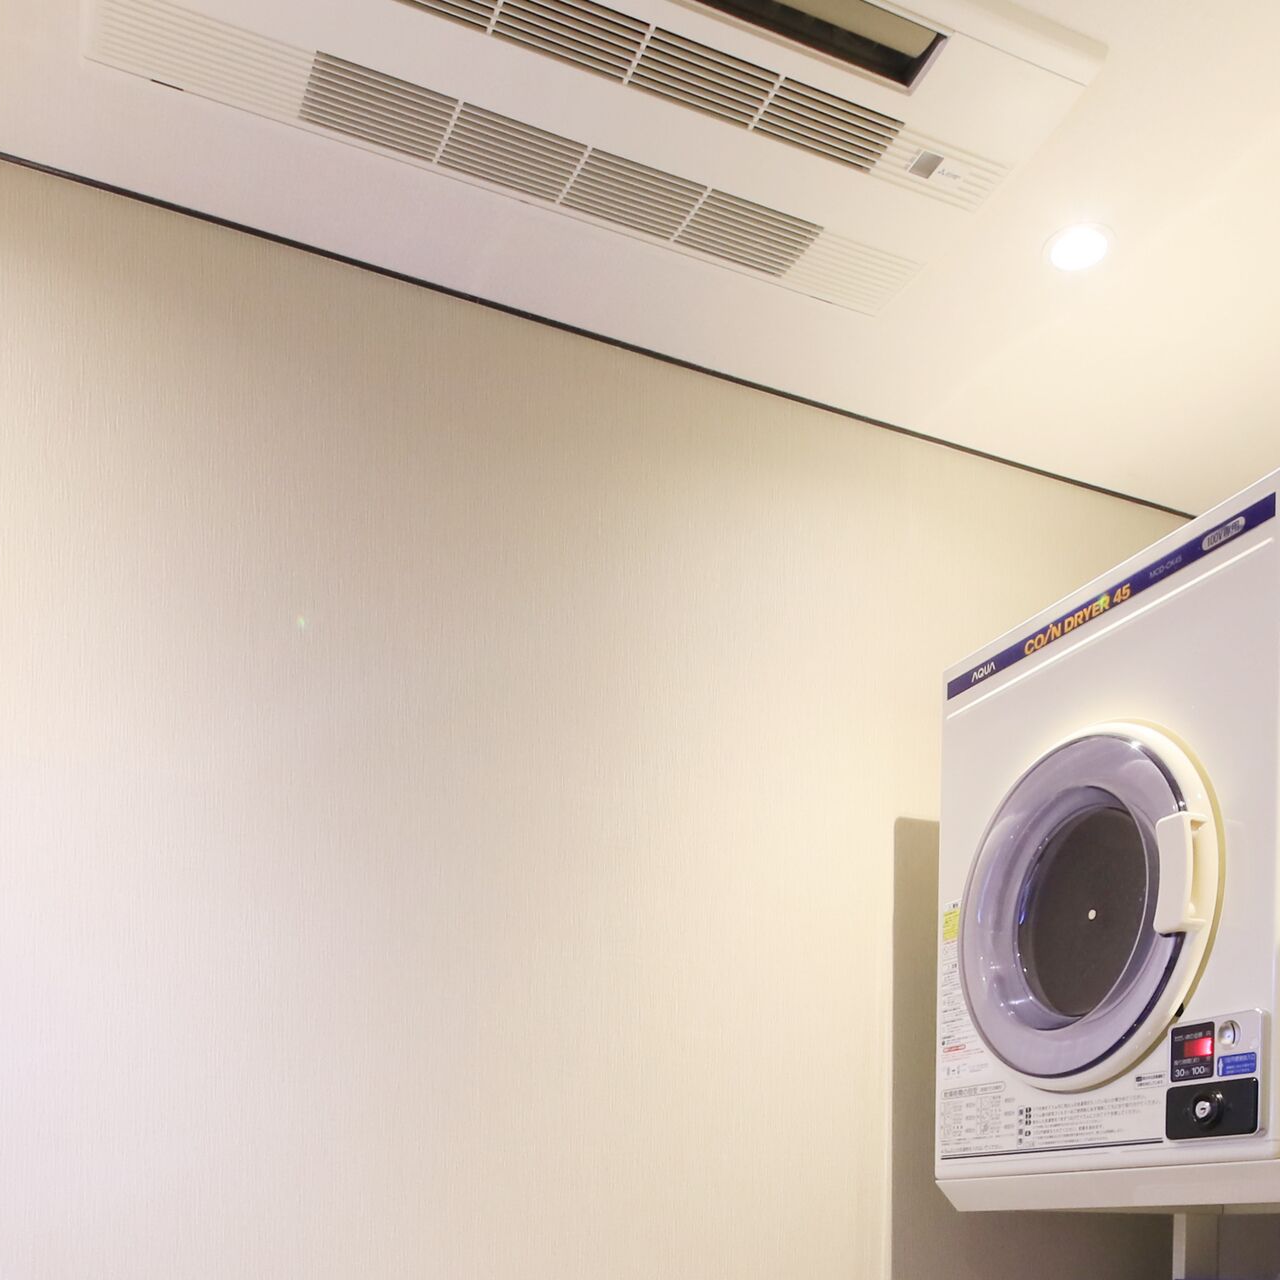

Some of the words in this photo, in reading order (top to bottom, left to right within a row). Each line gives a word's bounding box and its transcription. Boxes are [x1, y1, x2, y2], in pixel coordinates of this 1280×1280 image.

[1024, 623, 1061, 656] COIN
[1064, 593, 1111, 634] DRYER
[1113, 583, 1131, 603] 45
[971, 661, 996, 683] AQUA
